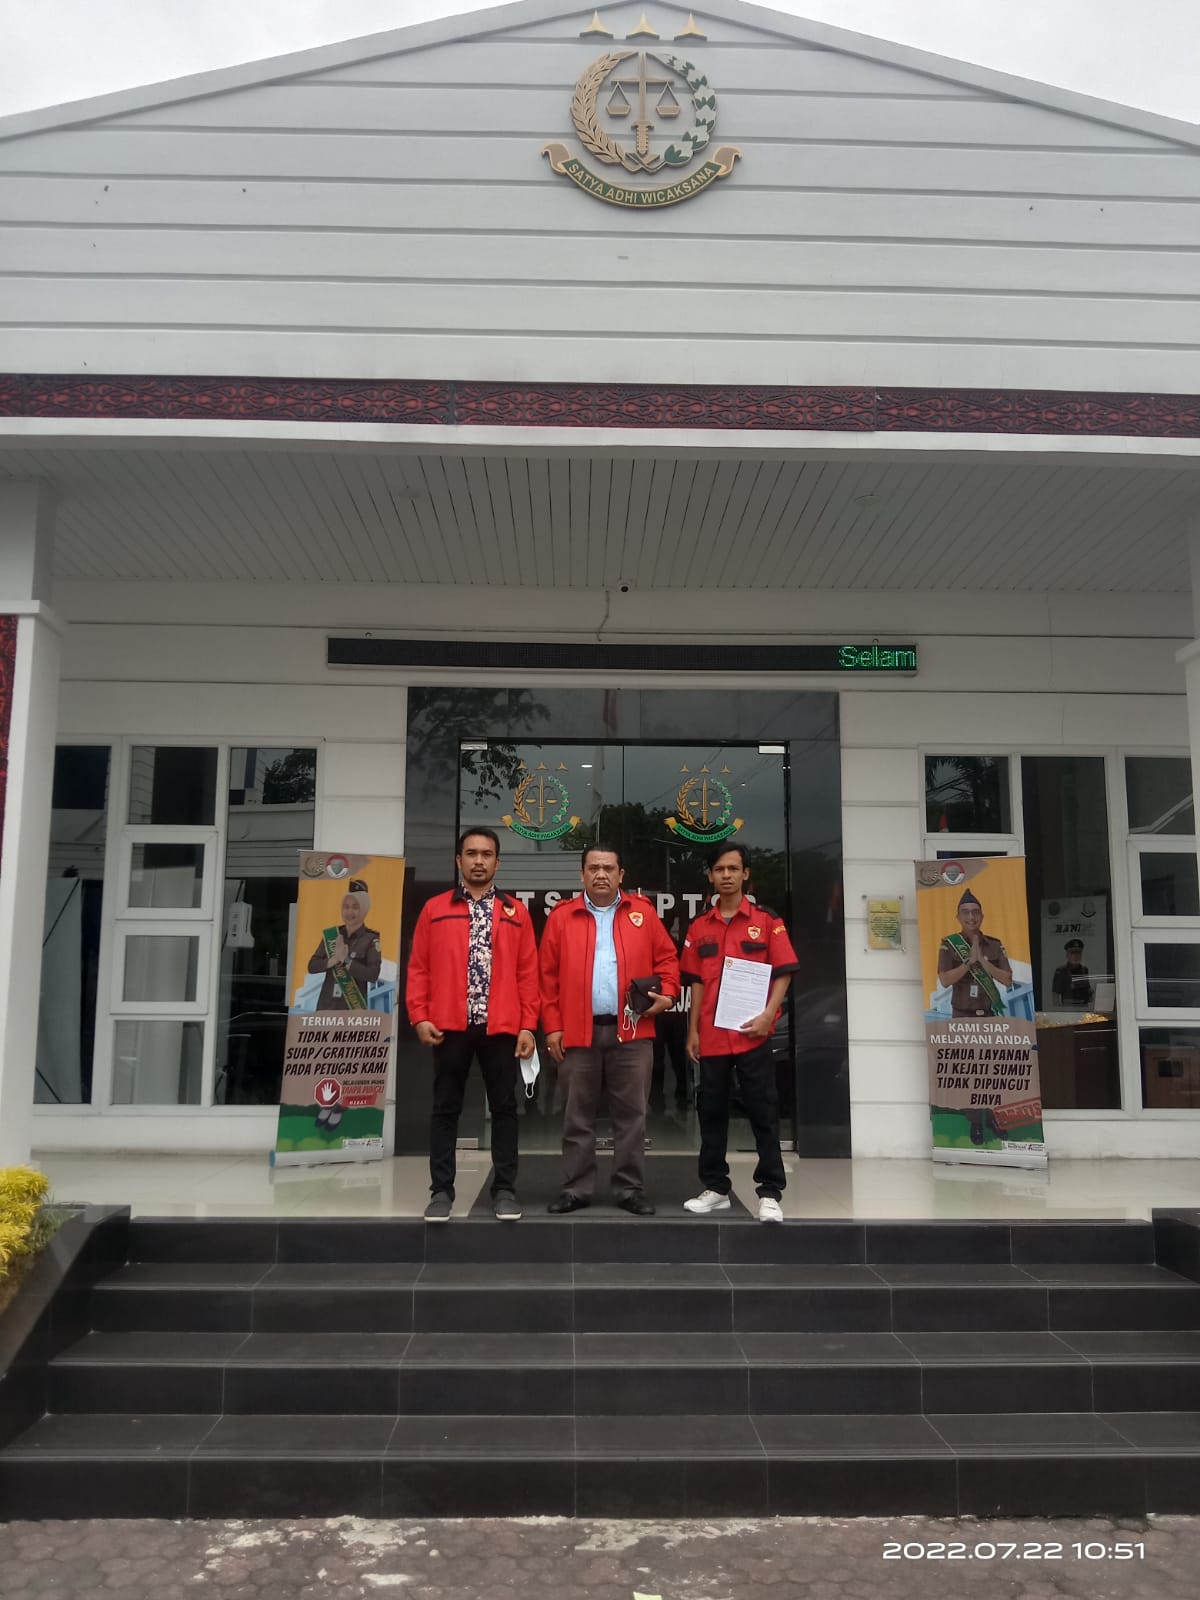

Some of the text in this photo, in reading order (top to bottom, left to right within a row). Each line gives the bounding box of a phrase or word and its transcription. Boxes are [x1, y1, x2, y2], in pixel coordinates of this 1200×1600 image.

[568, 163, 715, 204] SATYA ADHI WICAKSANA
[839, 646, 916, 667] Selam
[301, 1016, 381, 1026] TERIMA KASIH
[949, 1023, 1010, 1033] KAMI SIAP
[298, 1031, 381, 1043] TIDAK MEMBERI
[930, 1035, 1031, 1045] MELAYANI ANDA
[286, 1046, 389, 1060] SUAP/GRATIFIKASI
[937, 1048, 1030, 1061] SEMUA LAYANAN
[284, 1062, 388, 1076] PADA PETUGAS KAMI
[936, 1063, 1032, 1076] DI KEJATI SUMUT
[937, 1077, 1030, 1091] TIDAK DIPUNGUT
[970, 1094, 1002, 1105] BIAYA
